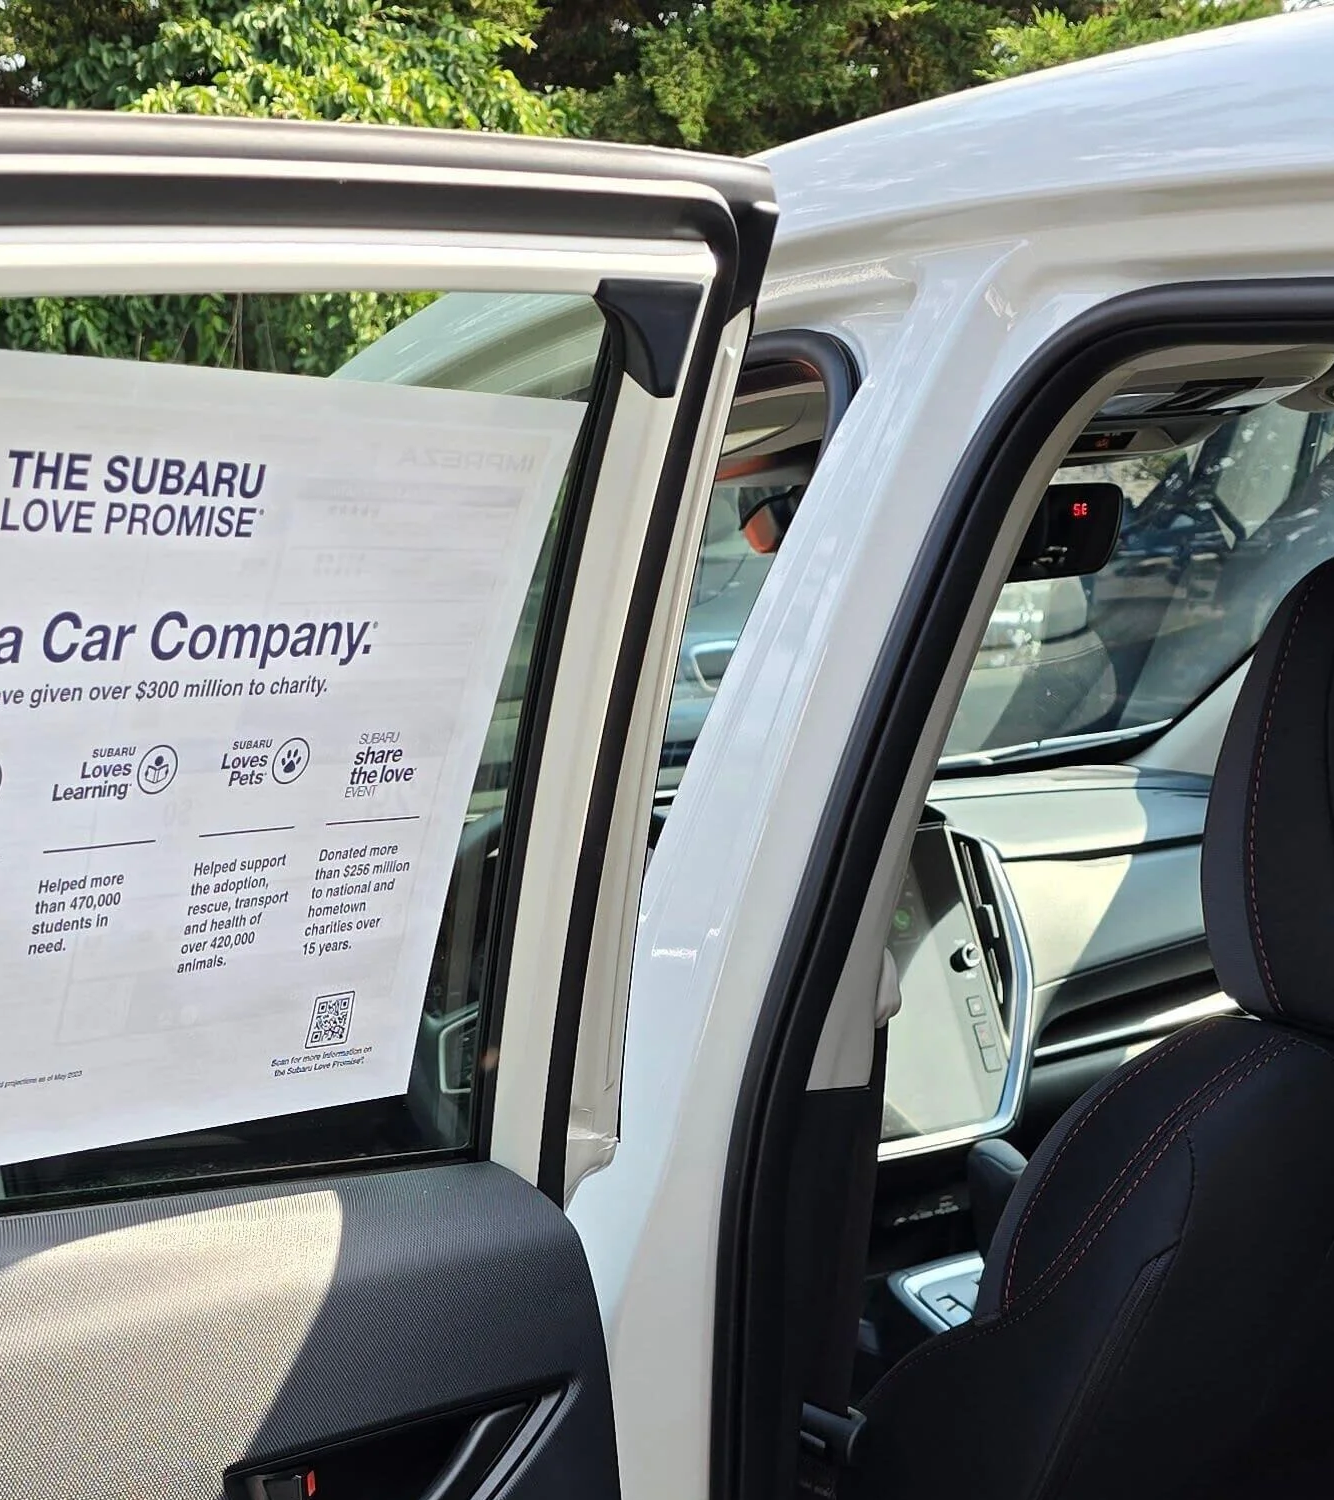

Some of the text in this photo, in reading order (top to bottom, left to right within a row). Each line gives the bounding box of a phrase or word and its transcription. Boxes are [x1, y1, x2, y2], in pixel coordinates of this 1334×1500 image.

[8, 450, 266, 499] THE SUBARU
[0, 498, 96, 533] LOVE
[43, 611, 137, 663] Car
[29, 684, 83, 708] given
[89, 685, 132, 701] over
[135, 680, 179, 702] $300
[183, 679, 243, 698] million
[248, 679, 265, 696] to
[270, 675, 327, 698] charity.
[232, 739, 273, 750] SUBARU
[359, 732, 400, 745] SUBARU
[92, 746, 137, 759] SUBARU
[221, 753, 268, 772] Loves
[354, 746, 403, 766] share
[80, 761, 132, 779] Loves
[350, 766, 378, 786] the
[345, 785, 378, 798] EVENT
[319, 845, 398, 862] Donated more
[193, 854, 286, 878] Helped support
[315, 860, 410, 881] than $256 million
[38, 874, 124, 895] Helped more
[191, 876, 269, 896] the adoption,
[311, 878, 396, 899] to national and
[35, 892, 121, 915] than 470,000
[187, 891, 289, 916] rescue, transport
[307, 902, 366, 918] hometown
[31, 913, 108, 935] students in
[184, 912, 263, 935] and health of
[304, 918, 381, 937] charities over
[28, 938, 66, 955] need.
[181, 931, 255, 954] over 420,000
[303, 940, 351, 957] 15 years.
[177, 954, 226, 973] animals.
